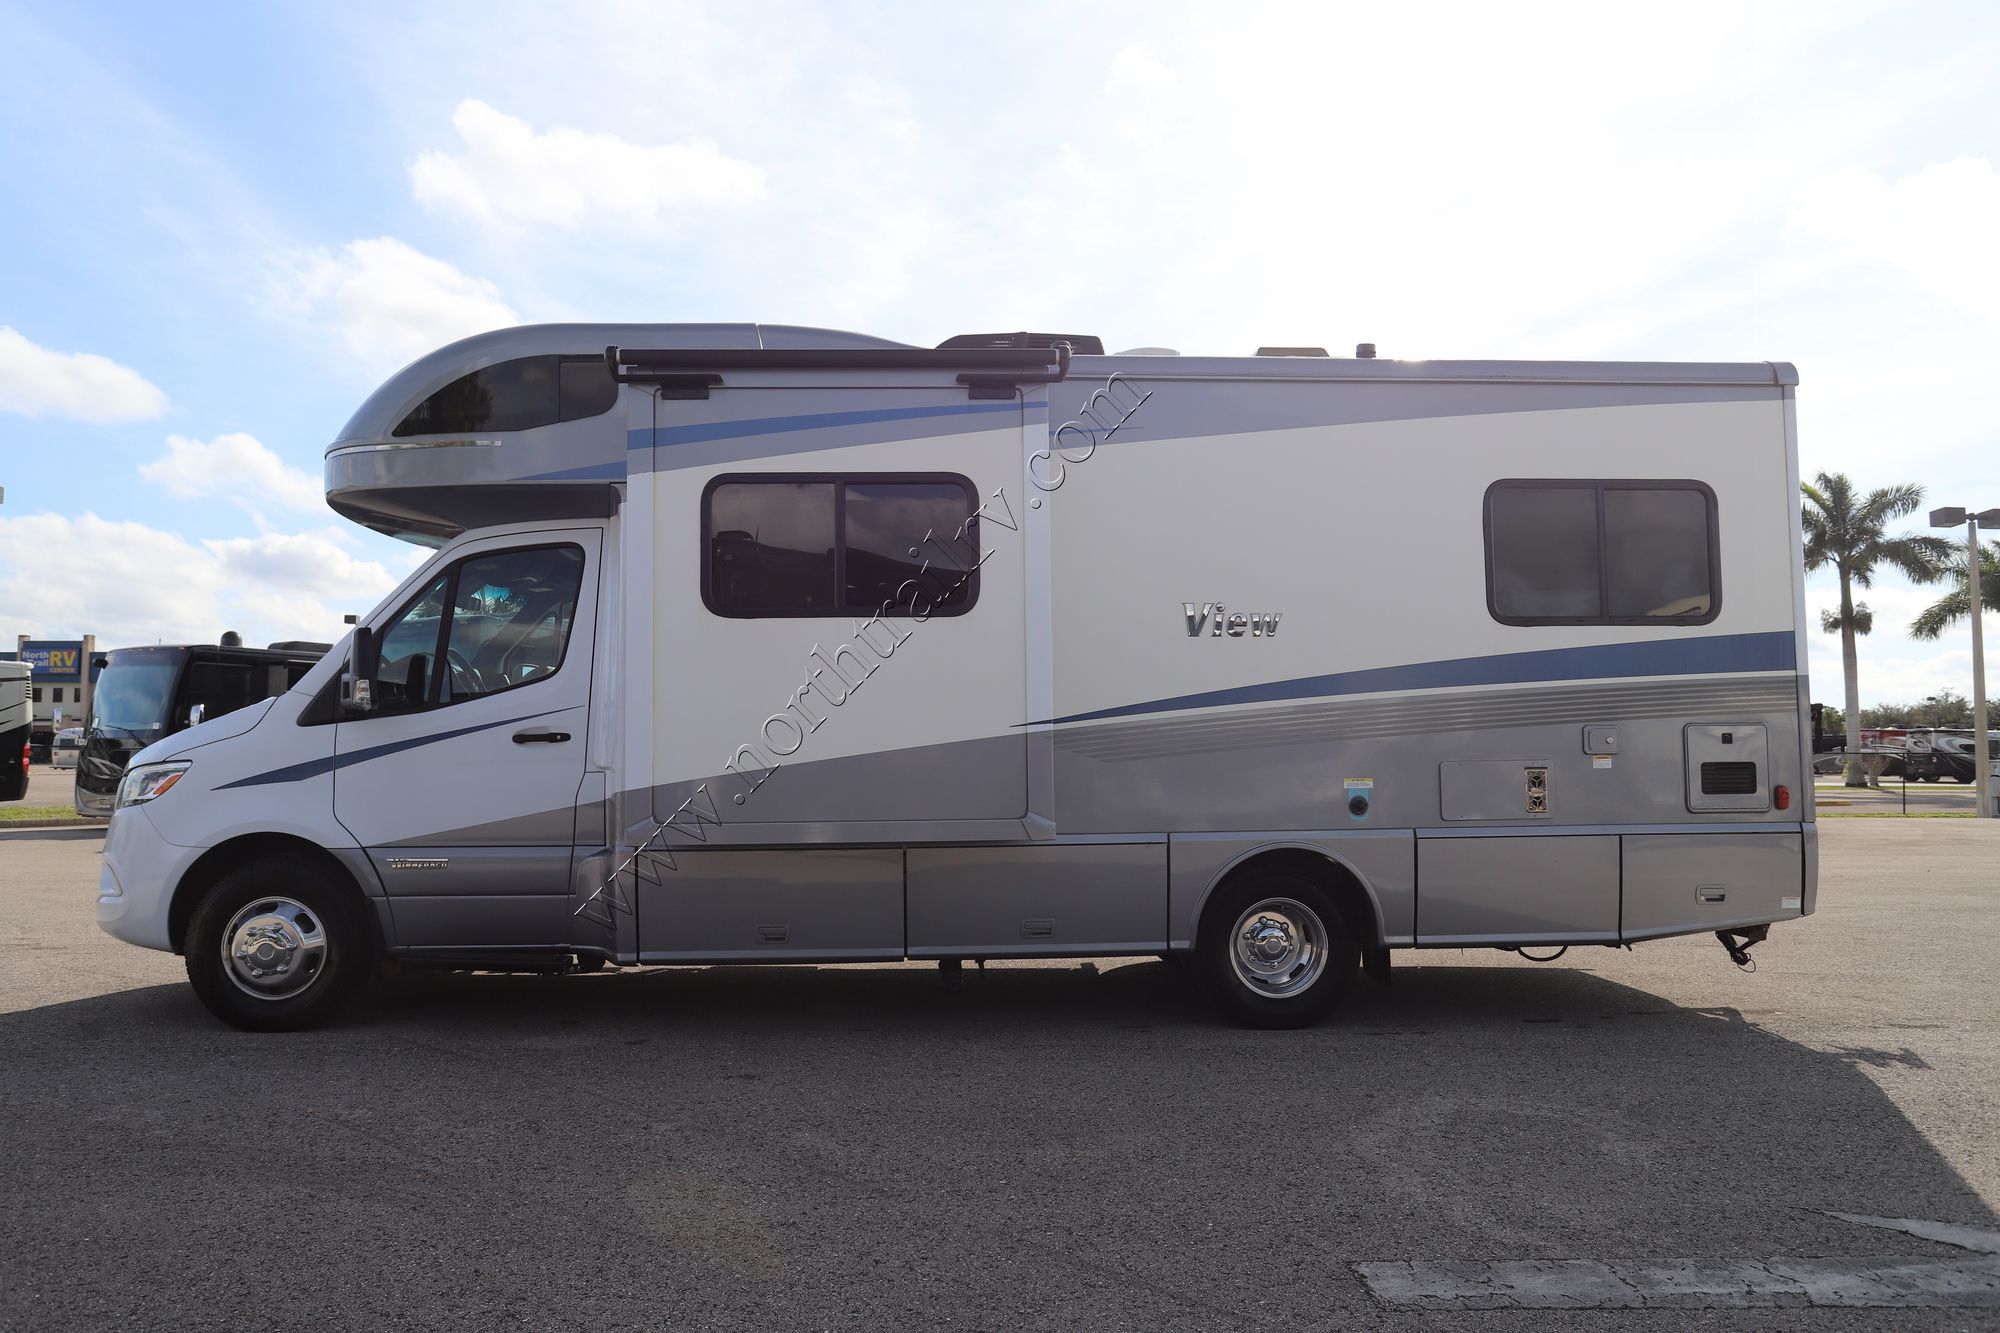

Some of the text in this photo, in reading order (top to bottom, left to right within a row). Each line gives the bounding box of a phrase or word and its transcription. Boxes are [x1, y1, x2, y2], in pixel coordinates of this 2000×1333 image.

[1182, 602, 1283, 637] View
[22, 651, 49, 659] North
[49, 651, 77, 667] RV
